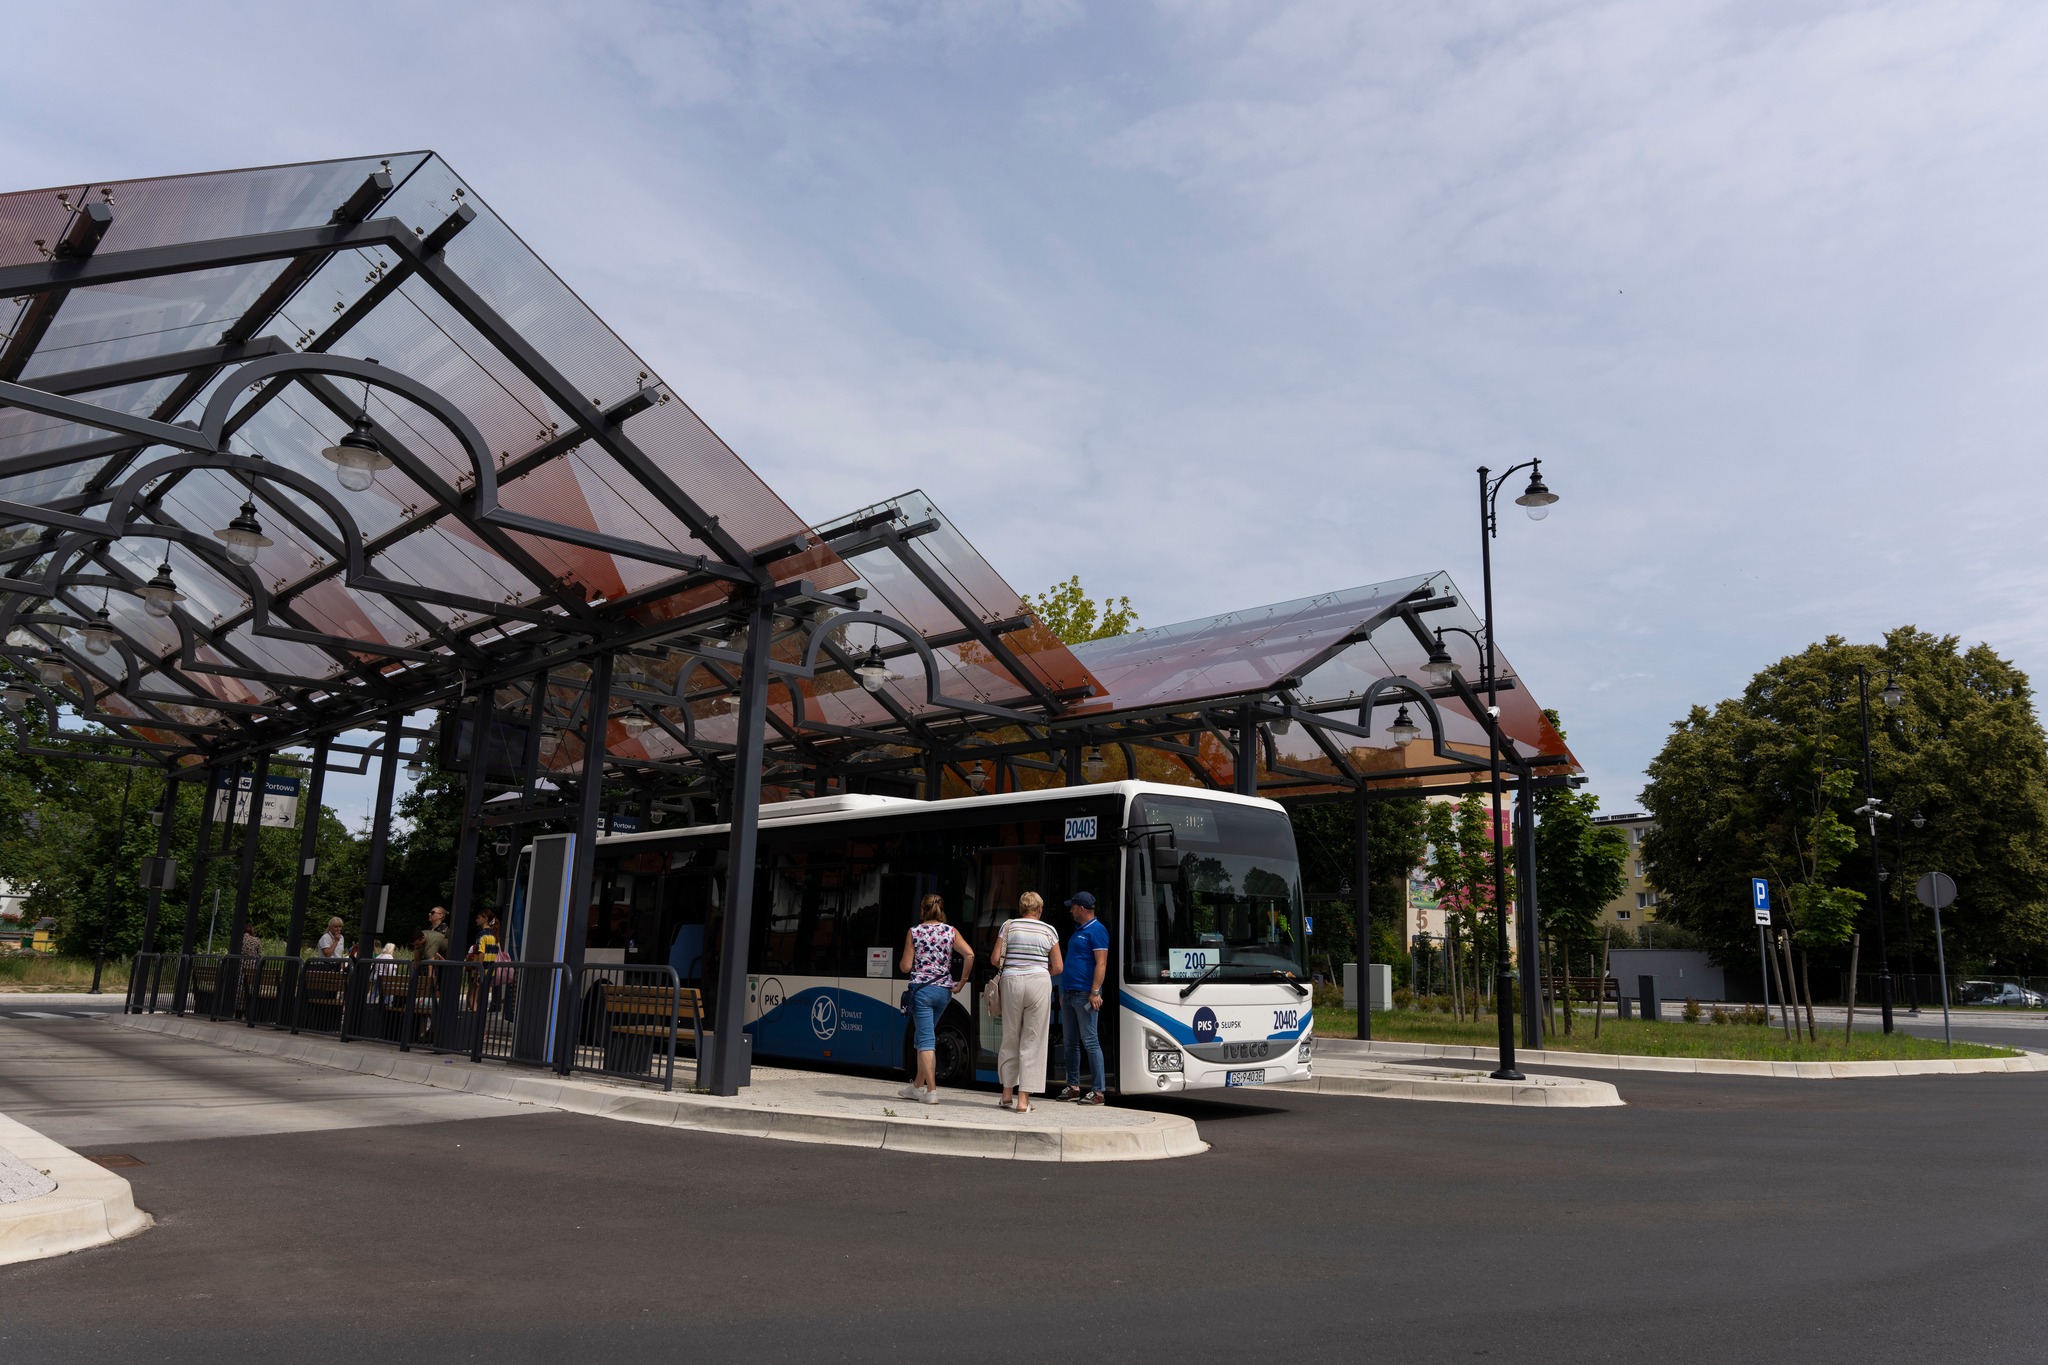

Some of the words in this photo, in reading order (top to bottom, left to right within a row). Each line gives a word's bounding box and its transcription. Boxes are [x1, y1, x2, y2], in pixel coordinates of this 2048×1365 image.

[1066, 819, 1096, 840] 20403
[1756, 882, 1766, 906] P
[1415, 910, 1429, 930] 5
[1184, 952, 1206, 970] 200
[764, 994, 779, 1006] PKS
[1197, 1020, 1213, 1031] PKS
[1221, 1020, 1242, 1029] SŁUPSK
[1273, 1010, 1298, 1030] 20403
[1223, 1041, 1269, 1059] IVECO
[1231, 1073, 1241, 1083] GS
[1243, 1070, 1263, 1082] 9403E
